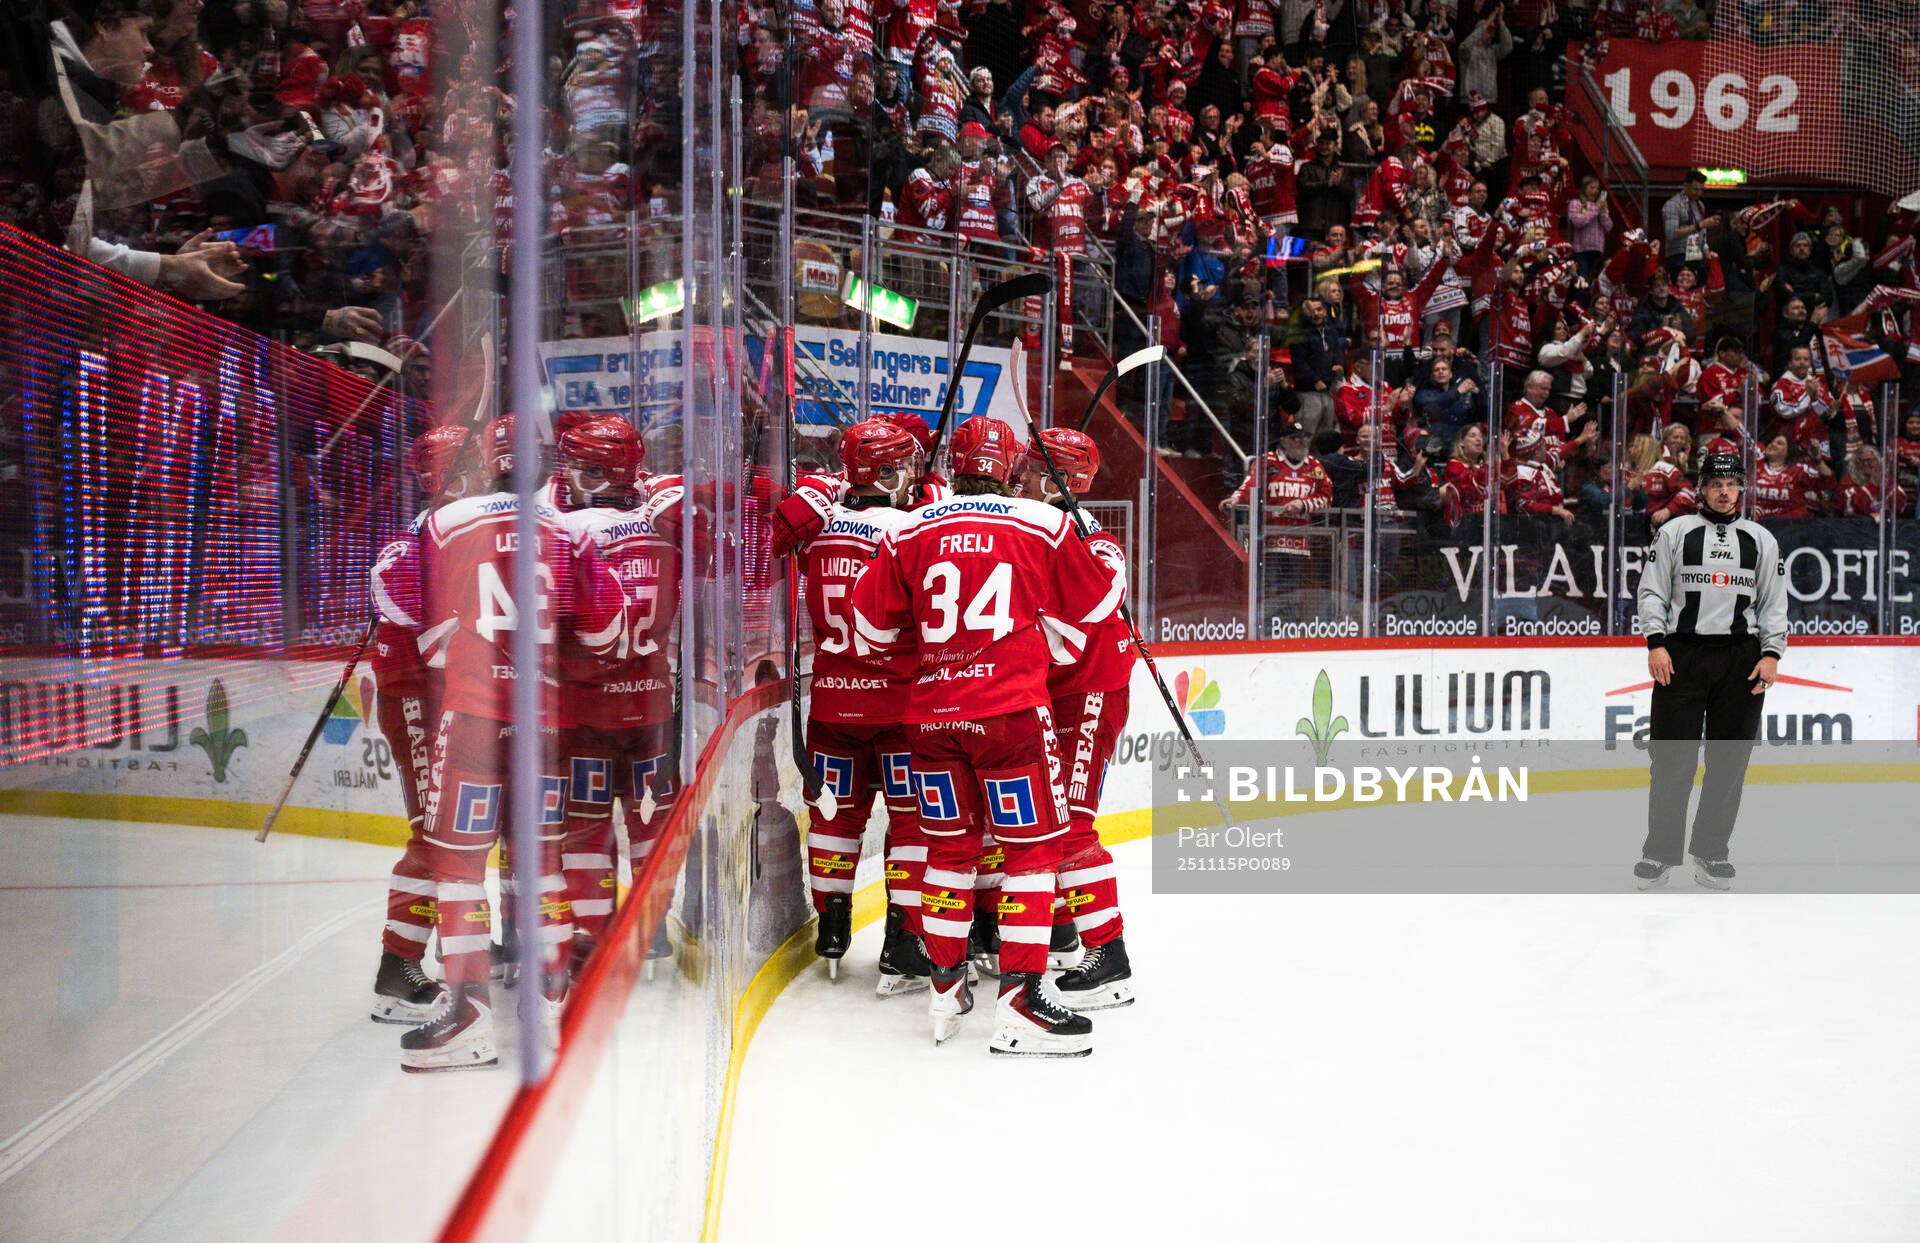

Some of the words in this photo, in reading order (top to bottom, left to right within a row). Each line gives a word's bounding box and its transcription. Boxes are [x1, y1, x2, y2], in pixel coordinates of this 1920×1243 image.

[1604, 67, 1800, 132] 1962
[829, 339, 931, 378] Selngers
[977, 458, 993, 473] 34
[1268, 482, 1316, 498] TIMR
[922, 501, 1014, 520] GOODWAY
[940, 533, 993, 556] FREIJ
[1709, 550, 1734, 560] SHL
[1681, 573, 1711, 585] TRYGG
[921, 560, 1015, 643] 34
[1161, 617, 1246, 642] Brandcode
[1271, 615, 1359, 639] Brandcode
[1386, 613, 1478, 637] Brandcode
[1506, 613, 1601, 637] Brandcode
[1360, 670, 1550, 738] LILIUM
